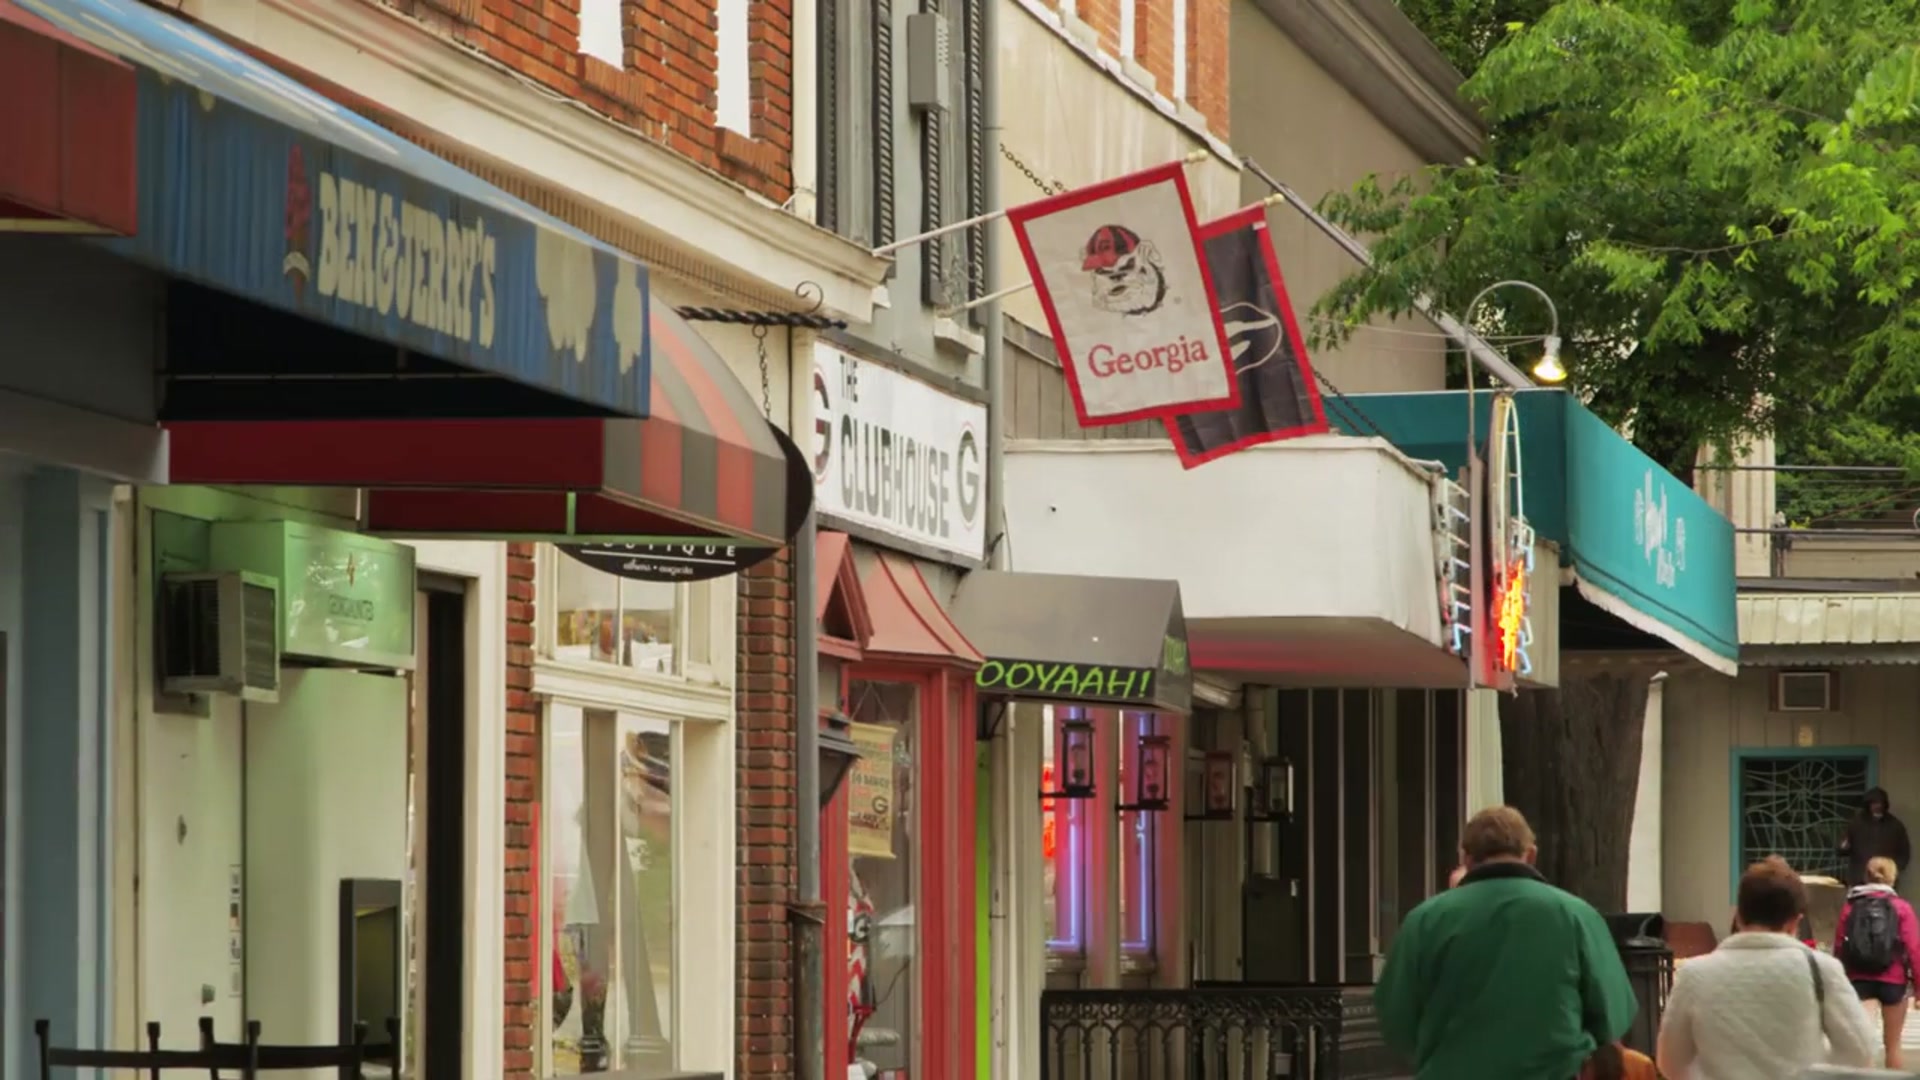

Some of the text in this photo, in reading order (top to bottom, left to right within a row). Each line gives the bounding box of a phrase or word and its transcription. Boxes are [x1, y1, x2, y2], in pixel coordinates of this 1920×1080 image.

[318, 171, 495, 349] BEN&JERRY'S
[840, 354, 858, 402] THE
[1087, 335, 1209, 378] Georgia
[841, 413, 950, 539] CLUBHOUSE
[957, 430, 980, 524] G
[582, 542, 736, 557] UTIQUE
[975, 660, 1151, 698] OOYAAH!
